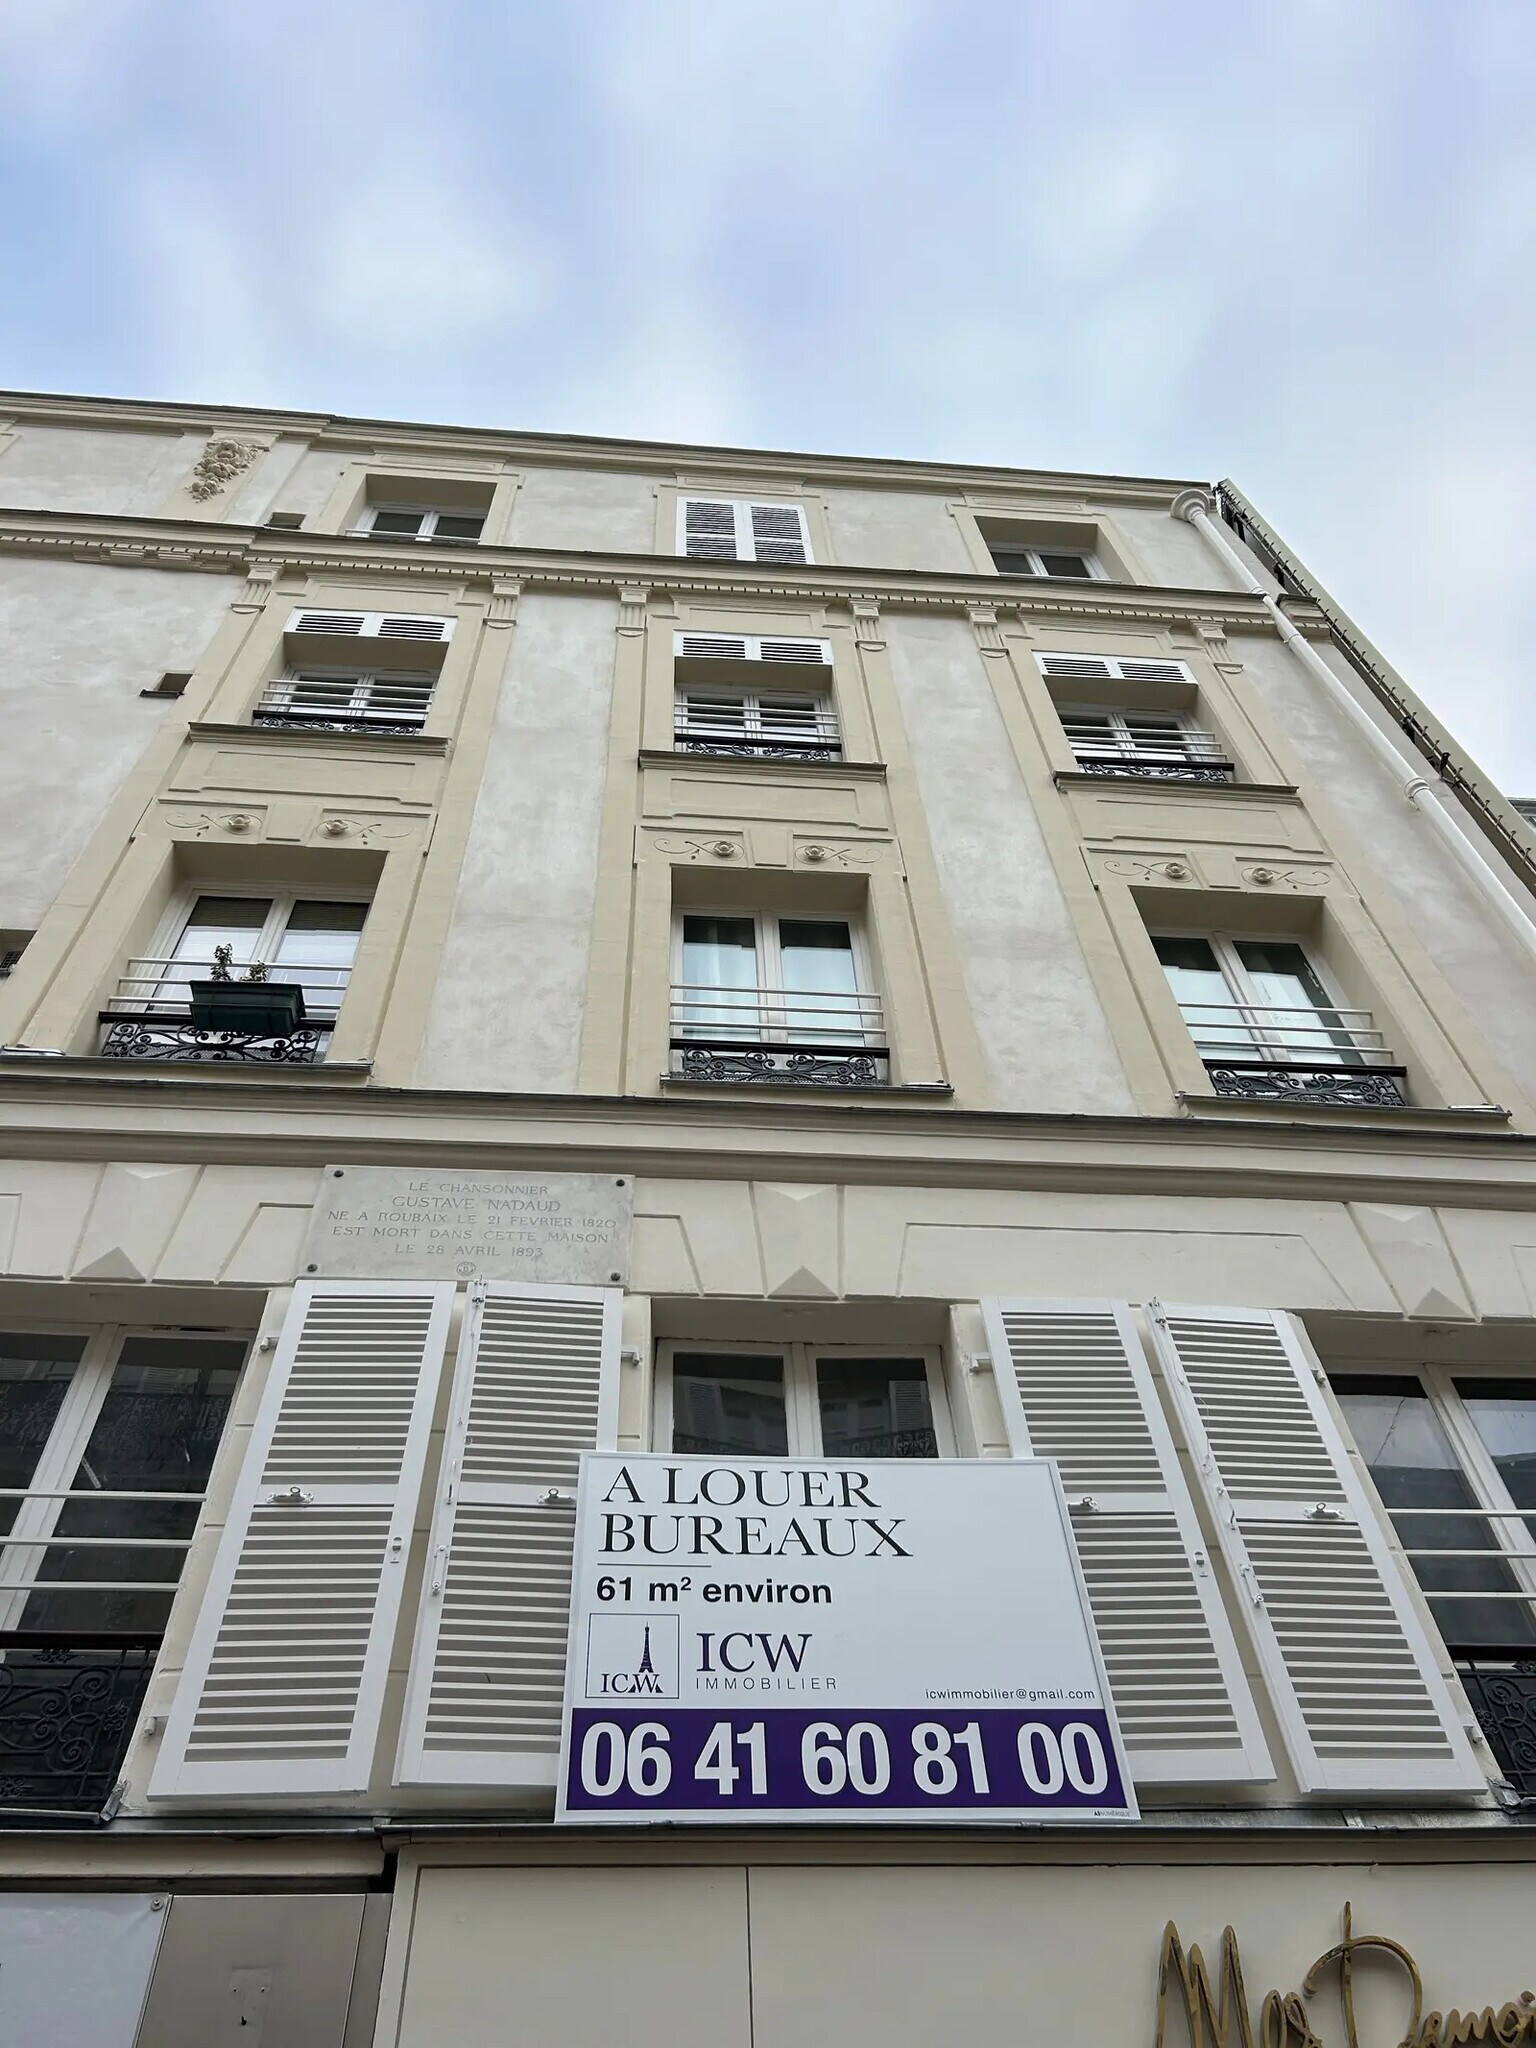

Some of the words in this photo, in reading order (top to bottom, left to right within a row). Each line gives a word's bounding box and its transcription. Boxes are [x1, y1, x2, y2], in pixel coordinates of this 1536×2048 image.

[408, 1182, 429, 1192] LE
[439, 1183, 548, 1196] CHANSONNIER
[392, 1196, 475, 1210] GUSTAVE
[487, 1199, 561, 1212] NADAUD
[327, 1210, 349, 1221] NE
[357, 1211, 368, 1221] A
[378, 1211, 448, 1223] ROUBAIX
[457, 1214, 477, 1225] LE
[487, 1215, 500, 1225] 21
[510, 1216, 573, 1227] FEVRIER
[582, 1218, 617, 1229] 1820
[332, 1225, 365, 1237] EST
[373, 1226, 420, 1238] MORT
[429, 1229, 472, 1240] DANS
[483, 1230, 537, 1241] CETTE
[547, 1231, 609, 1243] MAISON
[394, 1243, 416, 1254] LE
[427, 1244, 445, 1255] 28
[454, 1245, 500, 1257] AVRIL
[511, 1246, 544, 1258] 1893
[601, 1466, 644, 1503] A
[662, 1468, 881, 1507] LOUER
[598, 1514, 913, 1556] BUREAUX
[597, 1577, 631, 1601] 61
[703, 1579, 831, 1603] environ
[697, 1633, 812, 1672] ICW
[601, 1674, 663, 1693] ICW
[697, 1677, 836, 1689] IMMOBILIER
[926, 1689, 1095, 1701] icwimmobilier@gmail.com
[581, 1723, 671, 1796] 06
[695, 1723, 767, 1794] 41
[802, 1723, 890, 1794] 60
[912, 1723, 989, 1794] 81
[1017, 1722, 1108, 1795] 00
